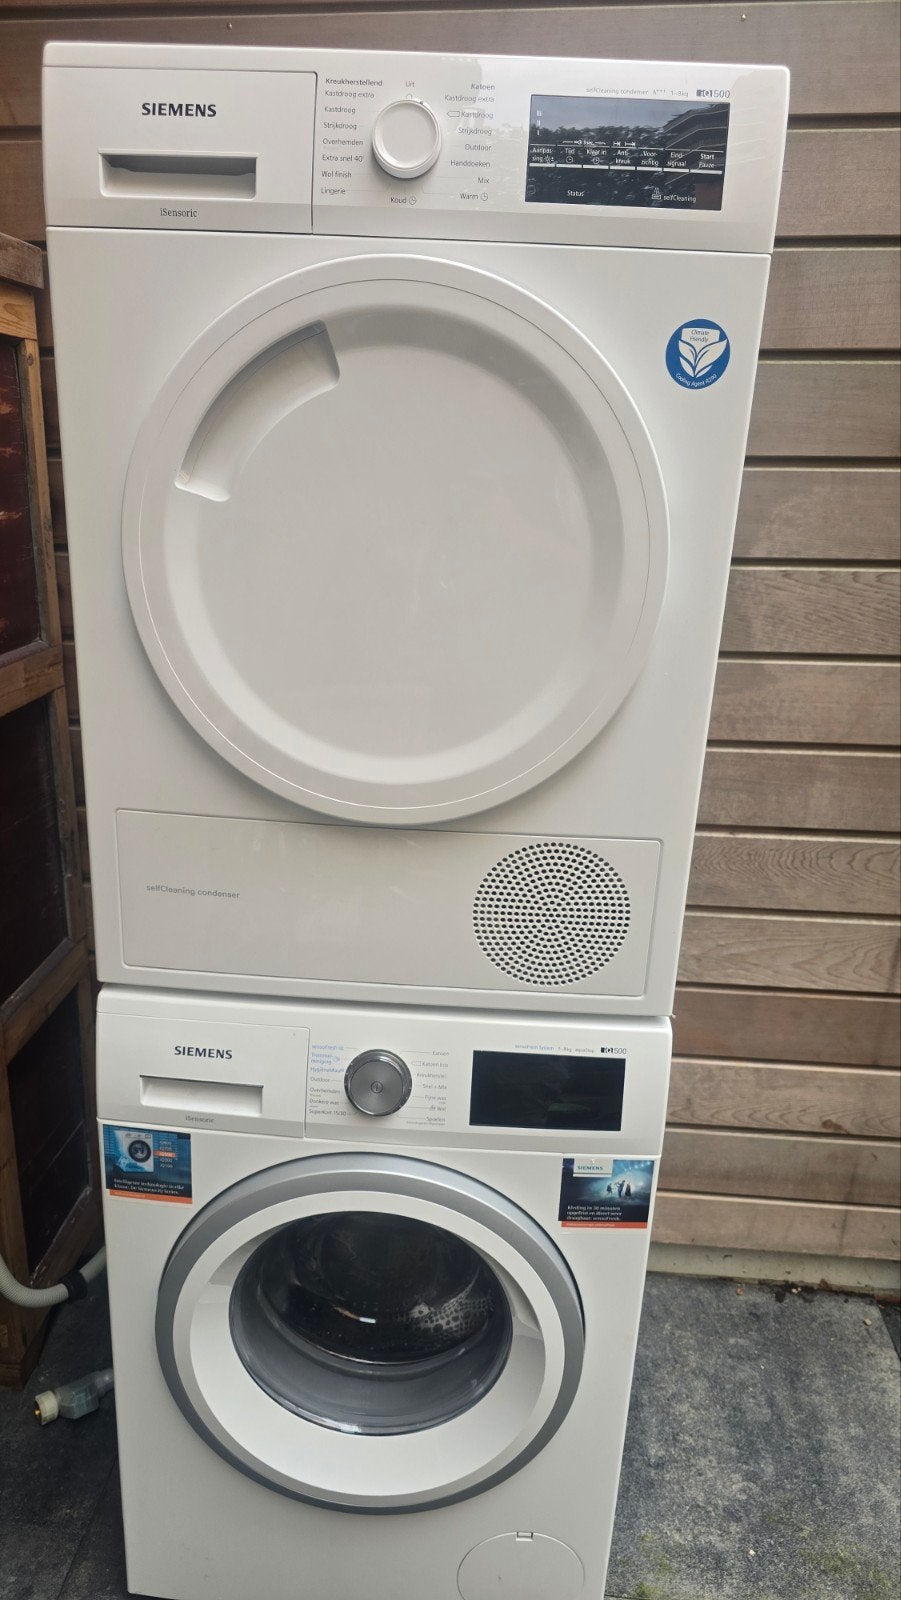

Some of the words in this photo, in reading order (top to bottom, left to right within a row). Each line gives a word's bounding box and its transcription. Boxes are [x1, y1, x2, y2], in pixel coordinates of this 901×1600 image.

[325, 78, 383, 87] Kreukherstellend
[470, 83, 496, 91] Katoen
[324, 90, 357, 98] Kastdroog
[357, 91, 375, 99] extra
[444, 94, 477, 103] Kastdroog
[141, 102, 217, 117] SIEMENS
[324, 106, 356, 114] Kastdroog
[461, 111, 494, 120] Kastdroog
[323, 121, 358, 131] Strijkdroog
[457, 127, 493, 136] Strijkdroog
[322, 138, 364, 146] Overhemden
[464, 143, 492, 151] Outdoor
[322, 154, 339, 162] Extra
[339, 154, 353, 162] snel
[450, 159, 491, 168] Handdoeken
[320, 187, 347, 196] Lingerie
[663, 194, 697, 203] selfCleaning
[160, 207, 198, 218] iSensoric
[146, 884, 196, 896] selfCleaning
[197, 889, 241, 899] condenser
[174, 1045, 233, 1060] SIEMENS
